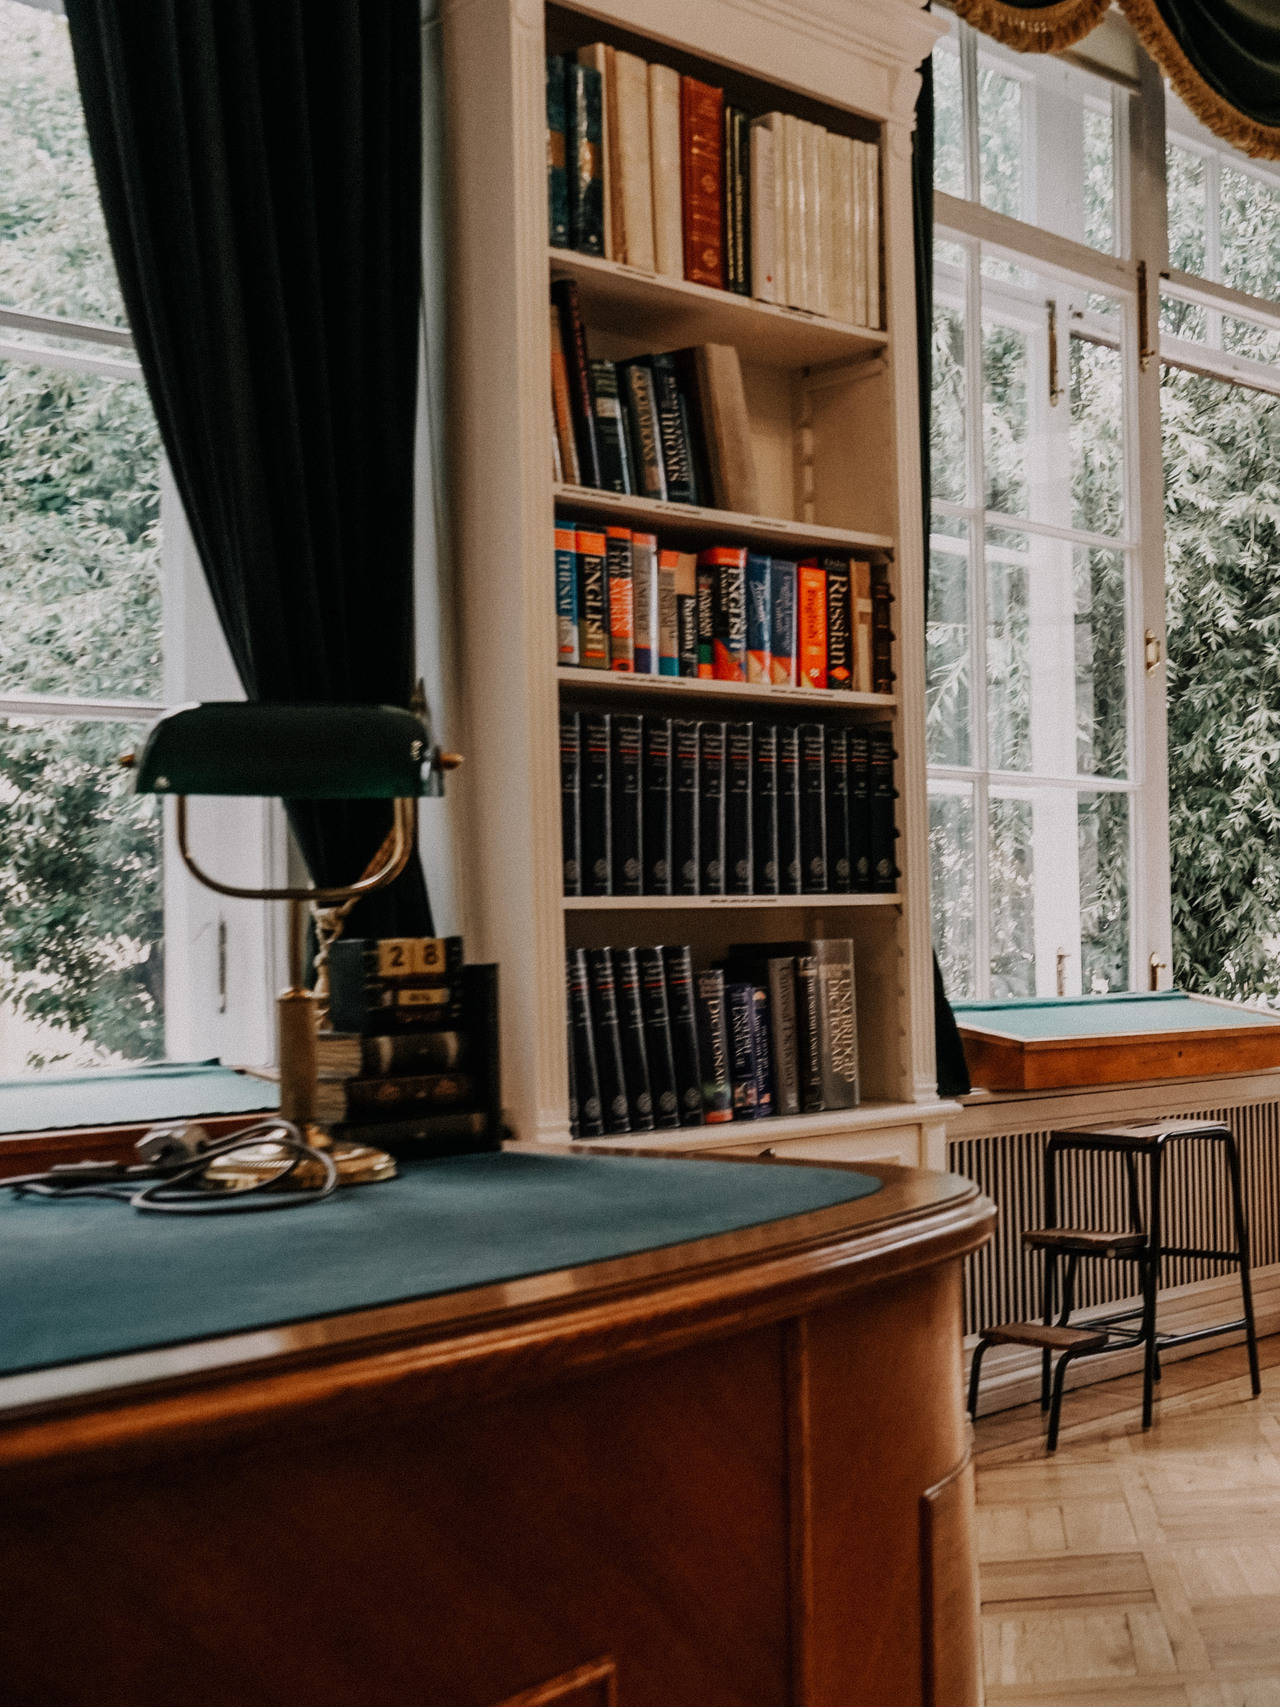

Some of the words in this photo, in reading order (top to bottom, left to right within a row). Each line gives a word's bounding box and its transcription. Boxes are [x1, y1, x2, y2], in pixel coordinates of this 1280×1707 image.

[661, 414, 680, 482] IDIOMS
[585, 557, 604, 650] ENGLISH
[729, 568, 746, 648] ENGLISH
[828, 575, 849, 664] Russian
[708, 1000, 726, 1093] DICTIONARY
[827, 980, 842, 1073] DICTIONARY
[839, 979, 856, 1082] UNABRIDGED
